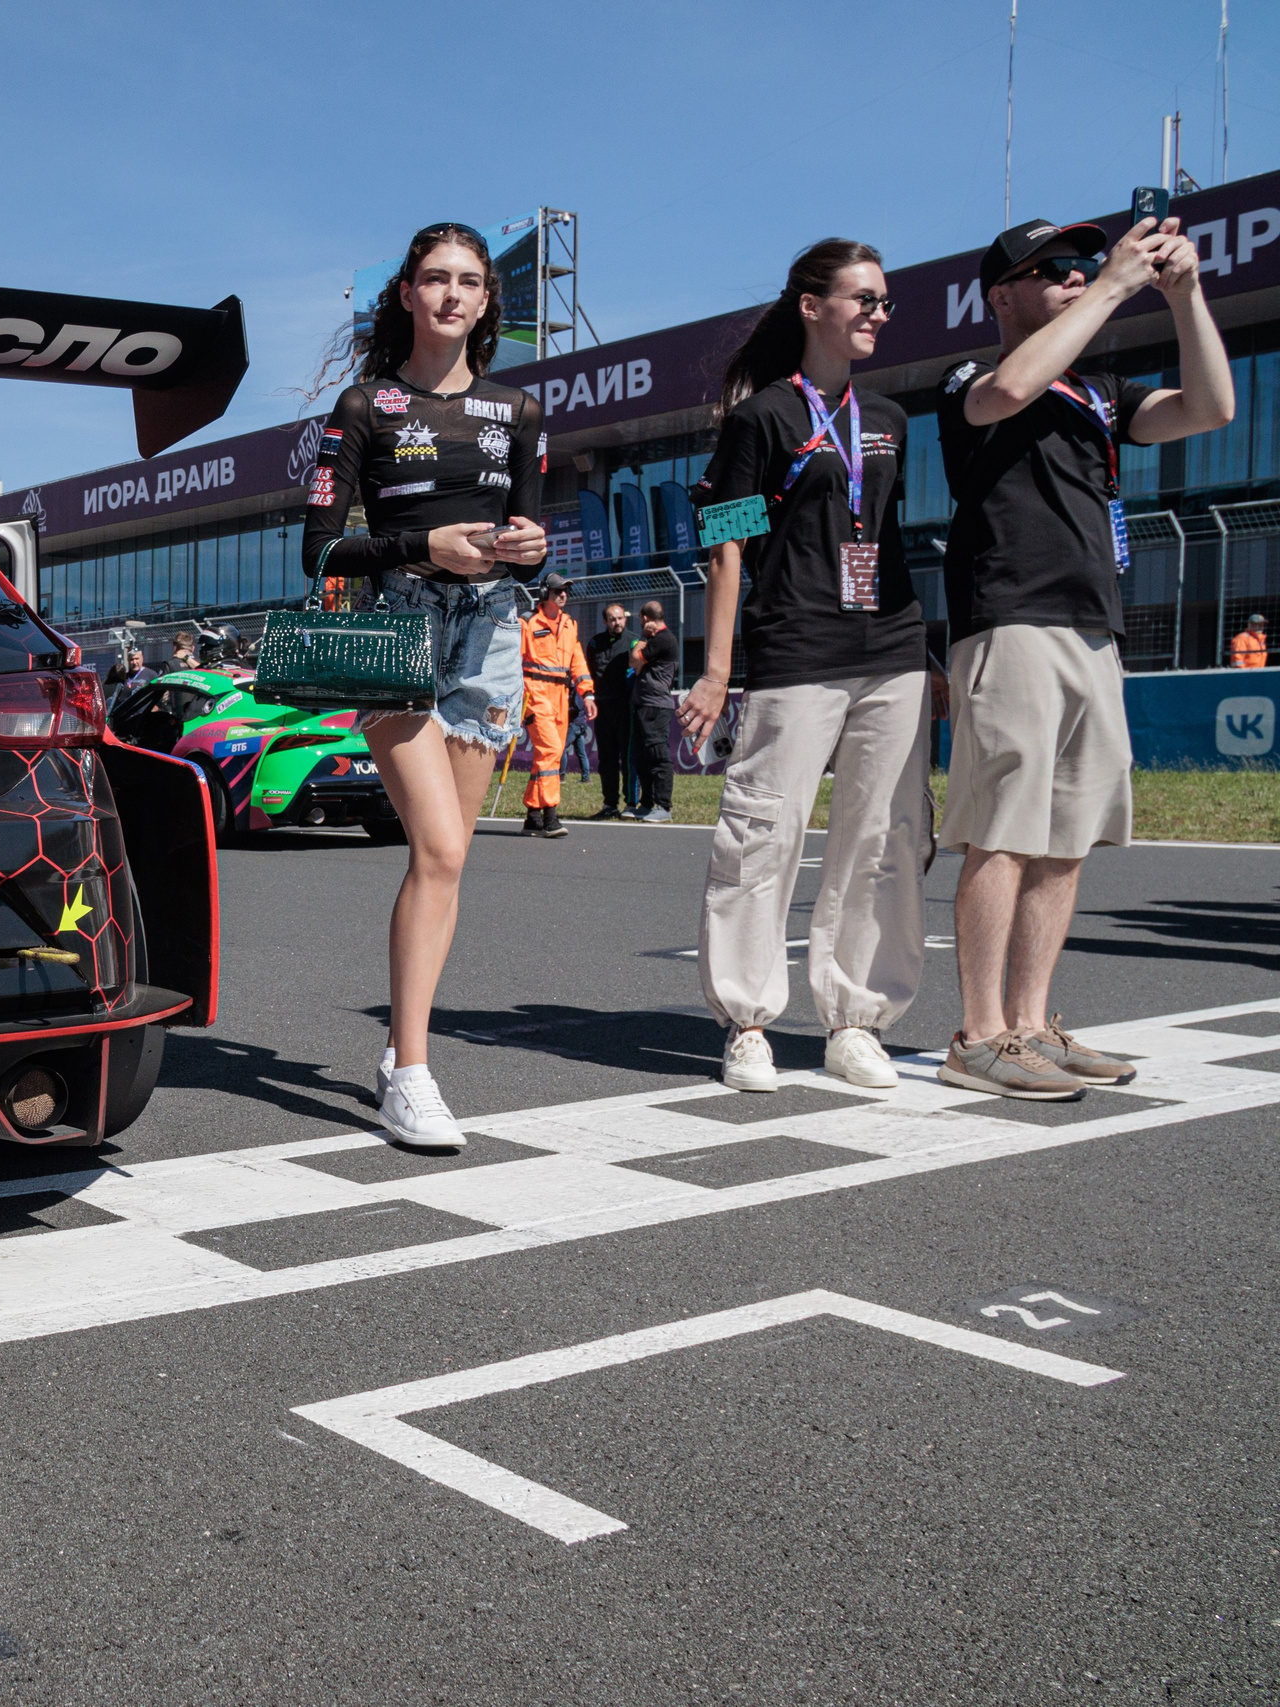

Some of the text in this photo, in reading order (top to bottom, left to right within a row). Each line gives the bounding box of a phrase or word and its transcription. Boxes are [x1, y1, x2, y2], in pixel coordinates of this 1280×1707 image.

[464, 397, 512, 423] BRKLYN
[84, 477, 149, 515] ИГОРА
[155, 457, 236, 504] ДРАЙВ
[231, 742, 247, 753] ВТБ
